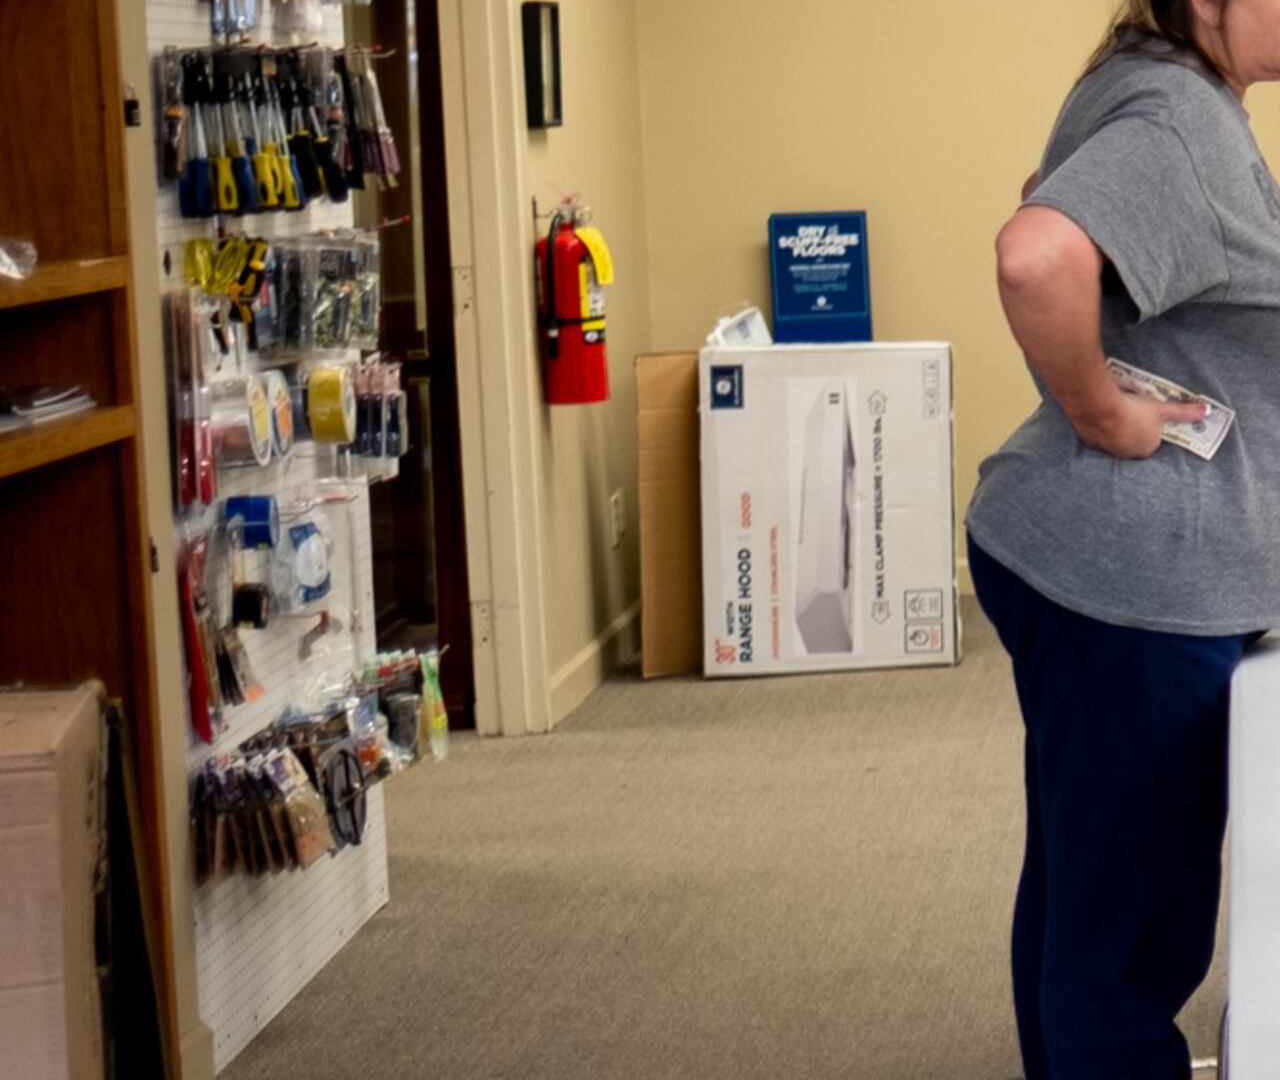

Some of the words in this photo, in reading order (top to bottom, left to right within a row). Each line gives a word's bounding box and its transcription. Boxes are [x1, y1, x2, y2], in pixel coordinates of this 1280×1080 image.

[874, 476, 884, 532] PRESSURE
[738, 548, 752, 600] HOOD
[875, 534, 885, 571] CLAMP
[875, 573, 884, 599] MAX
[739, 600, 752, 663] RANGE
